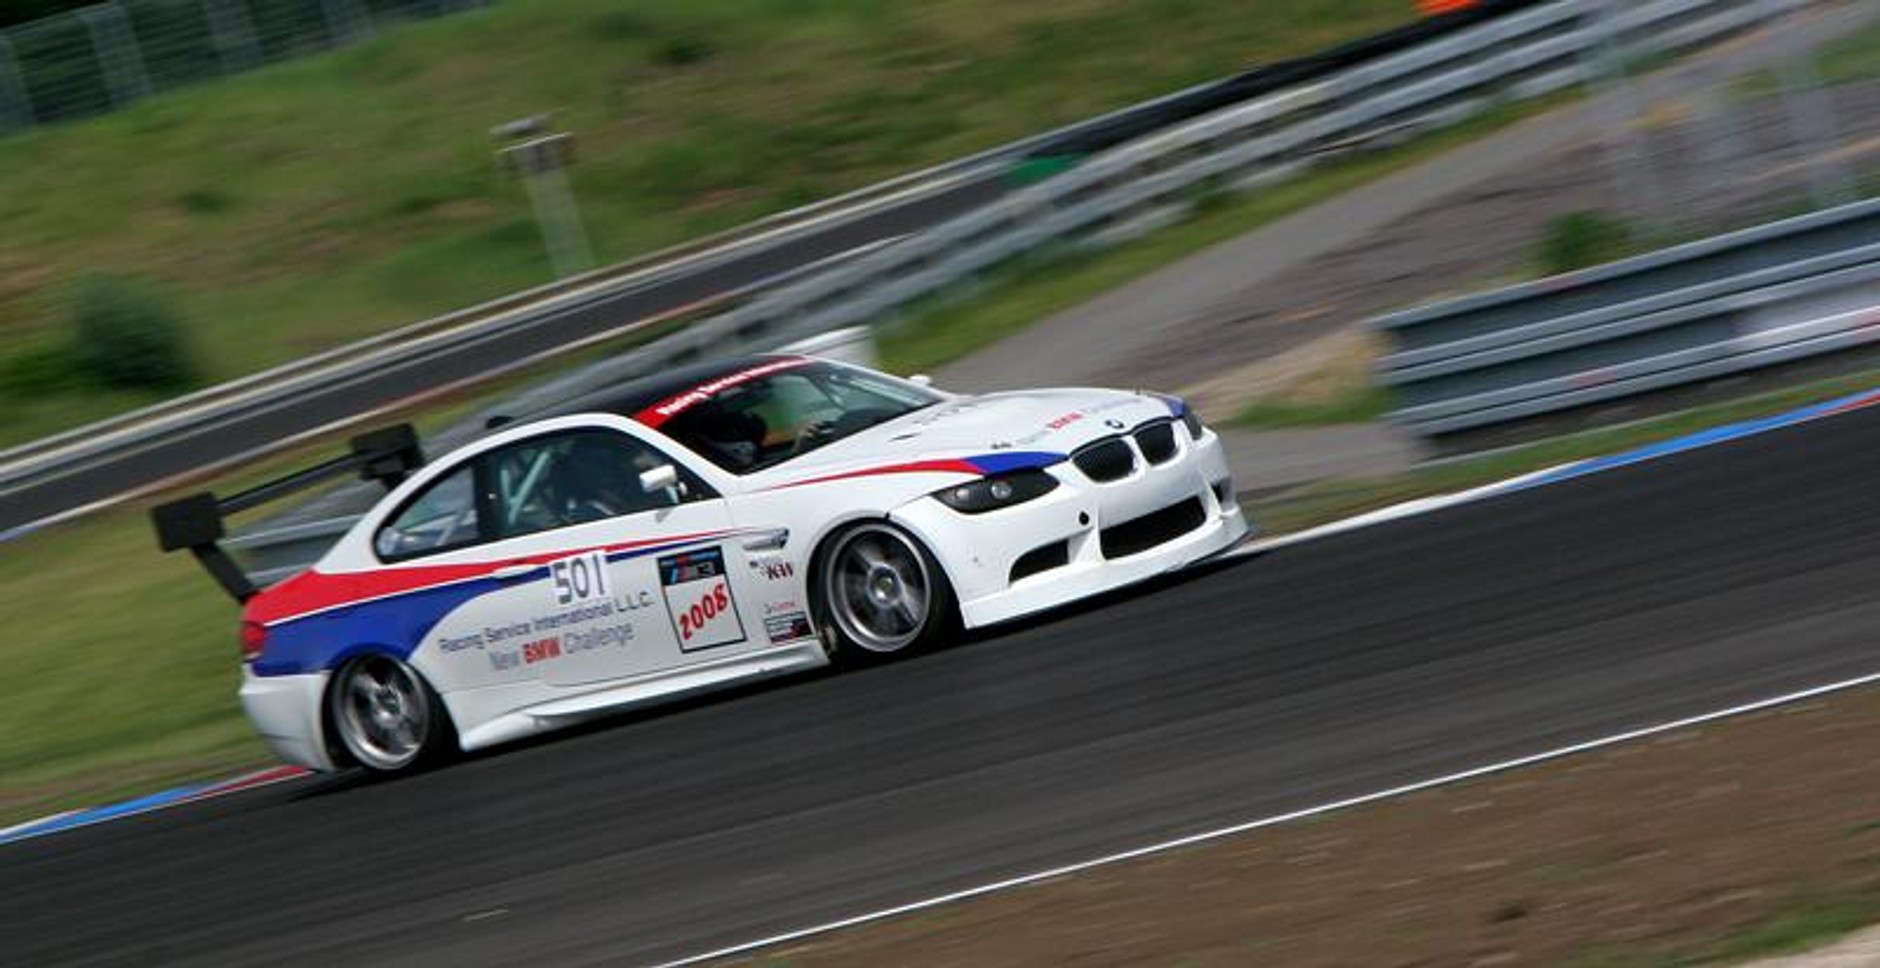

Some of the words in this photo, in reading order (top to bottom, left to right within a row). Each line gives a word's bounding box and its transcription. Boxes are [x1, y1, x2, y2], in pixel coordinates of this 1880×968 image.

[552, 554, 605, 604] 501
[438, 633, 483, 653] Racing
[484, 622, 532, 644] Service
[534, 600, 613, 632] International
[678, 583, 728, 641] 2008
[489, 650, 520, 671] New
[522, 636, 561, 664] BMW
[563, 622, 634, 654] Challenge
